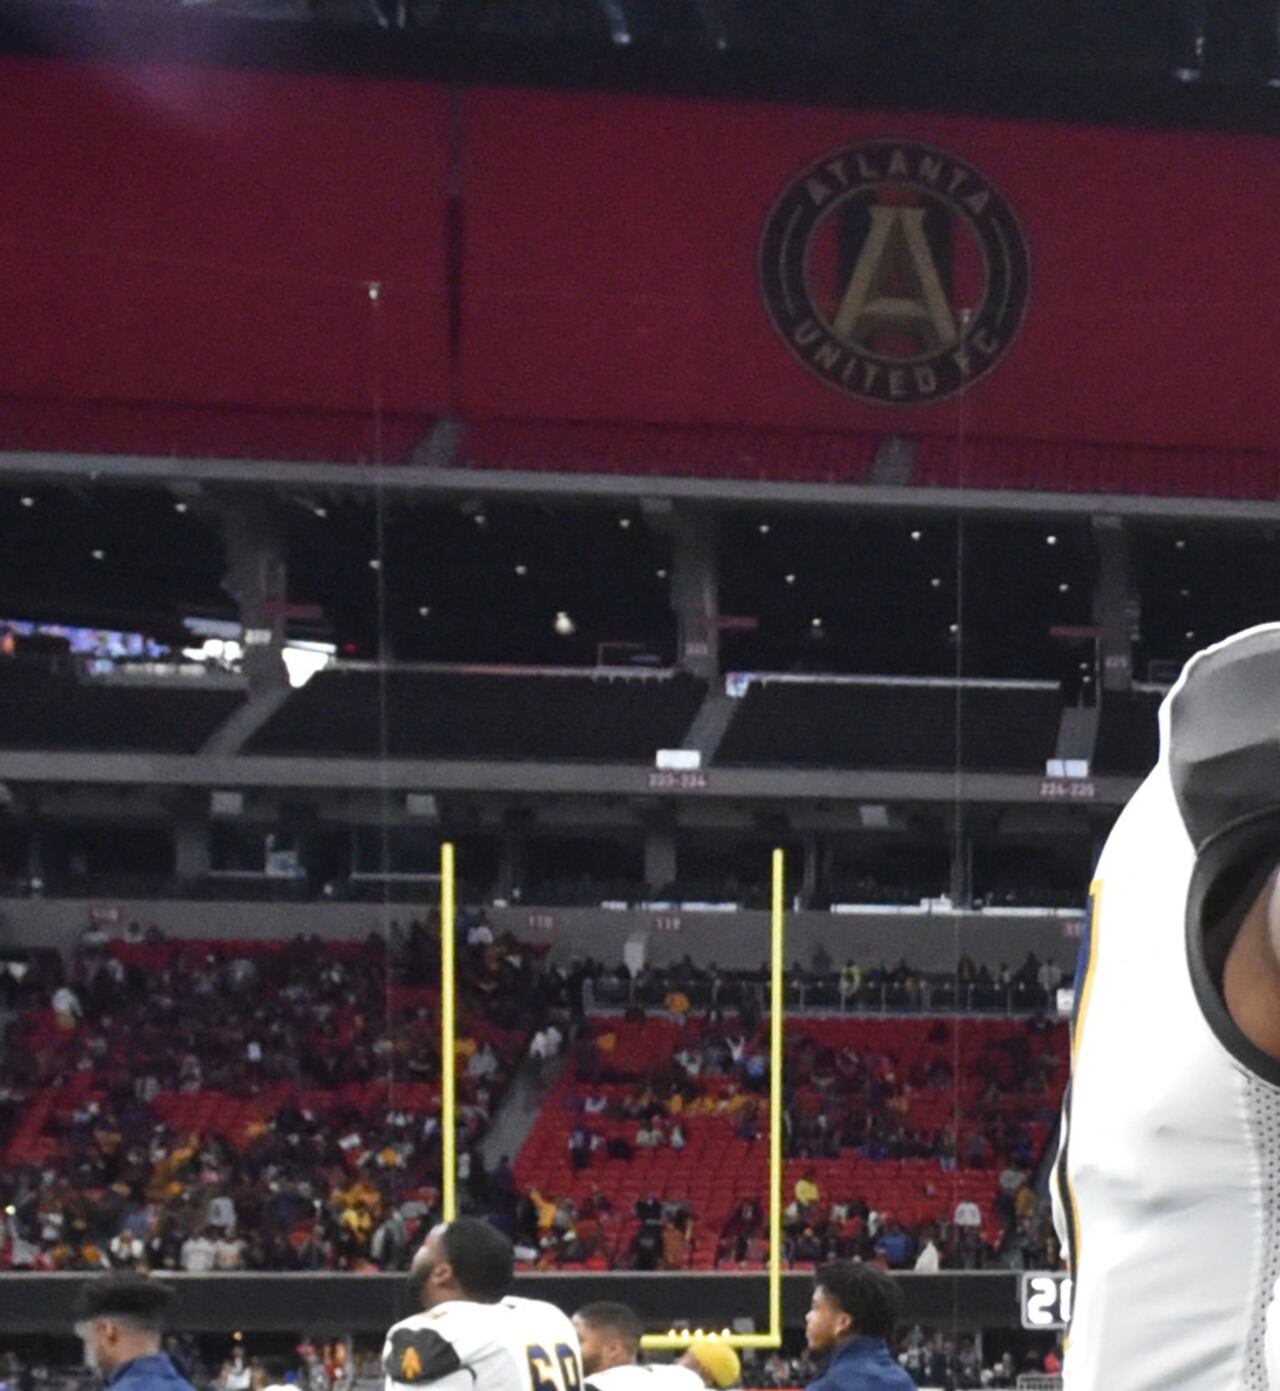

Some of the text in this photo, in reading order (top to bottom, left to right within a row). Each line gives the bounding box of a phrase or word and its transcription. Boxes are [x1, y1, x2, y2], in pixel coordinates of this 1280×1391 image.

[806, 149, 991, 216] ATLANTA
[793, 320, 999, 397] UNITED FC
